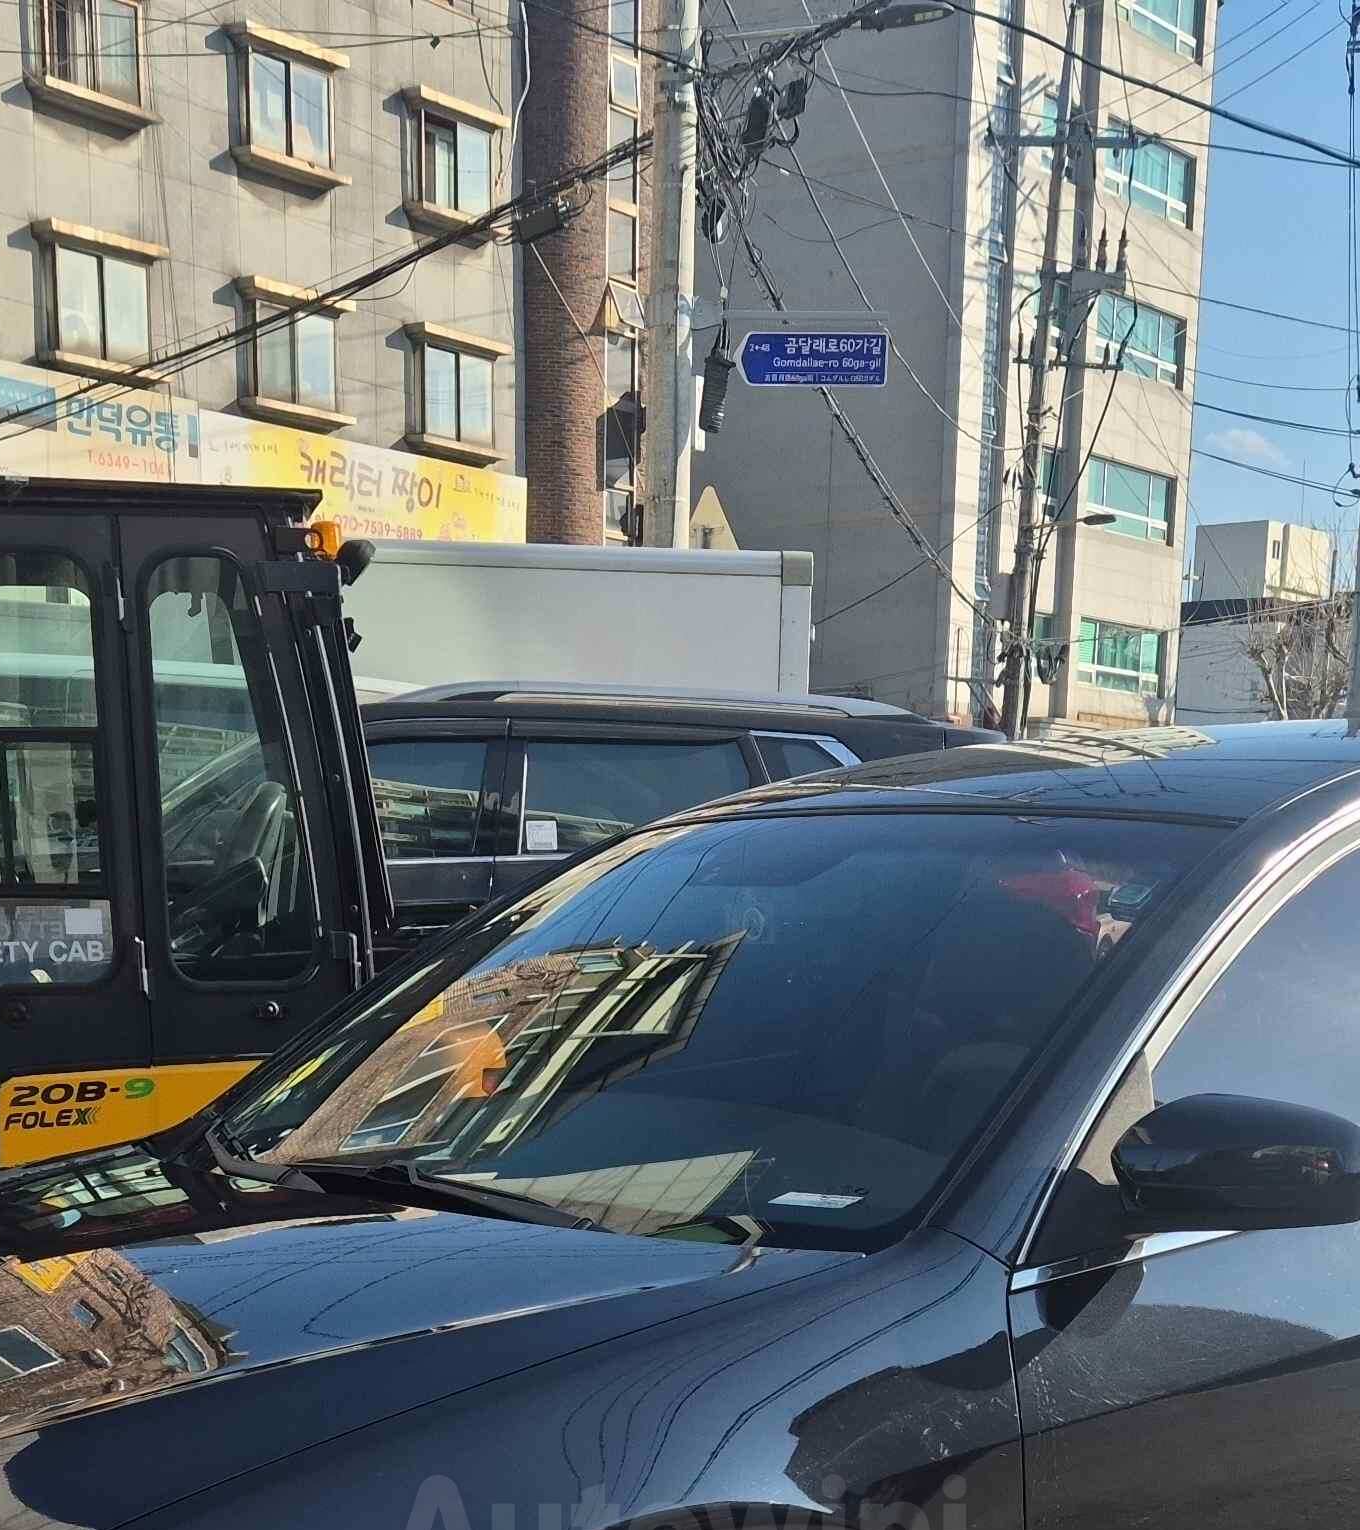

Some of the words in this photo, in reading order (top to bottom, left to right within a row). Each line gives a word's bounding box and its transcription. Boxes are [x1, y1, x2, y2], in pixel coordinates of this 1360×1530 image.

[785, 337, 882, 355] 곰달래로60가길
[773, 357, 839, 368] Gomdallae-ro
[842, 357, 881, 370] 60ga-gil
[65, 397, 181, 453] 만덕유통
[300, 450, 382, 499] 캐릭터
[48, 940, 105, 962] CAB
[9, 1078, 155, 1107] 20B-9
[4, 1108, 92, 1131] FOLEX
